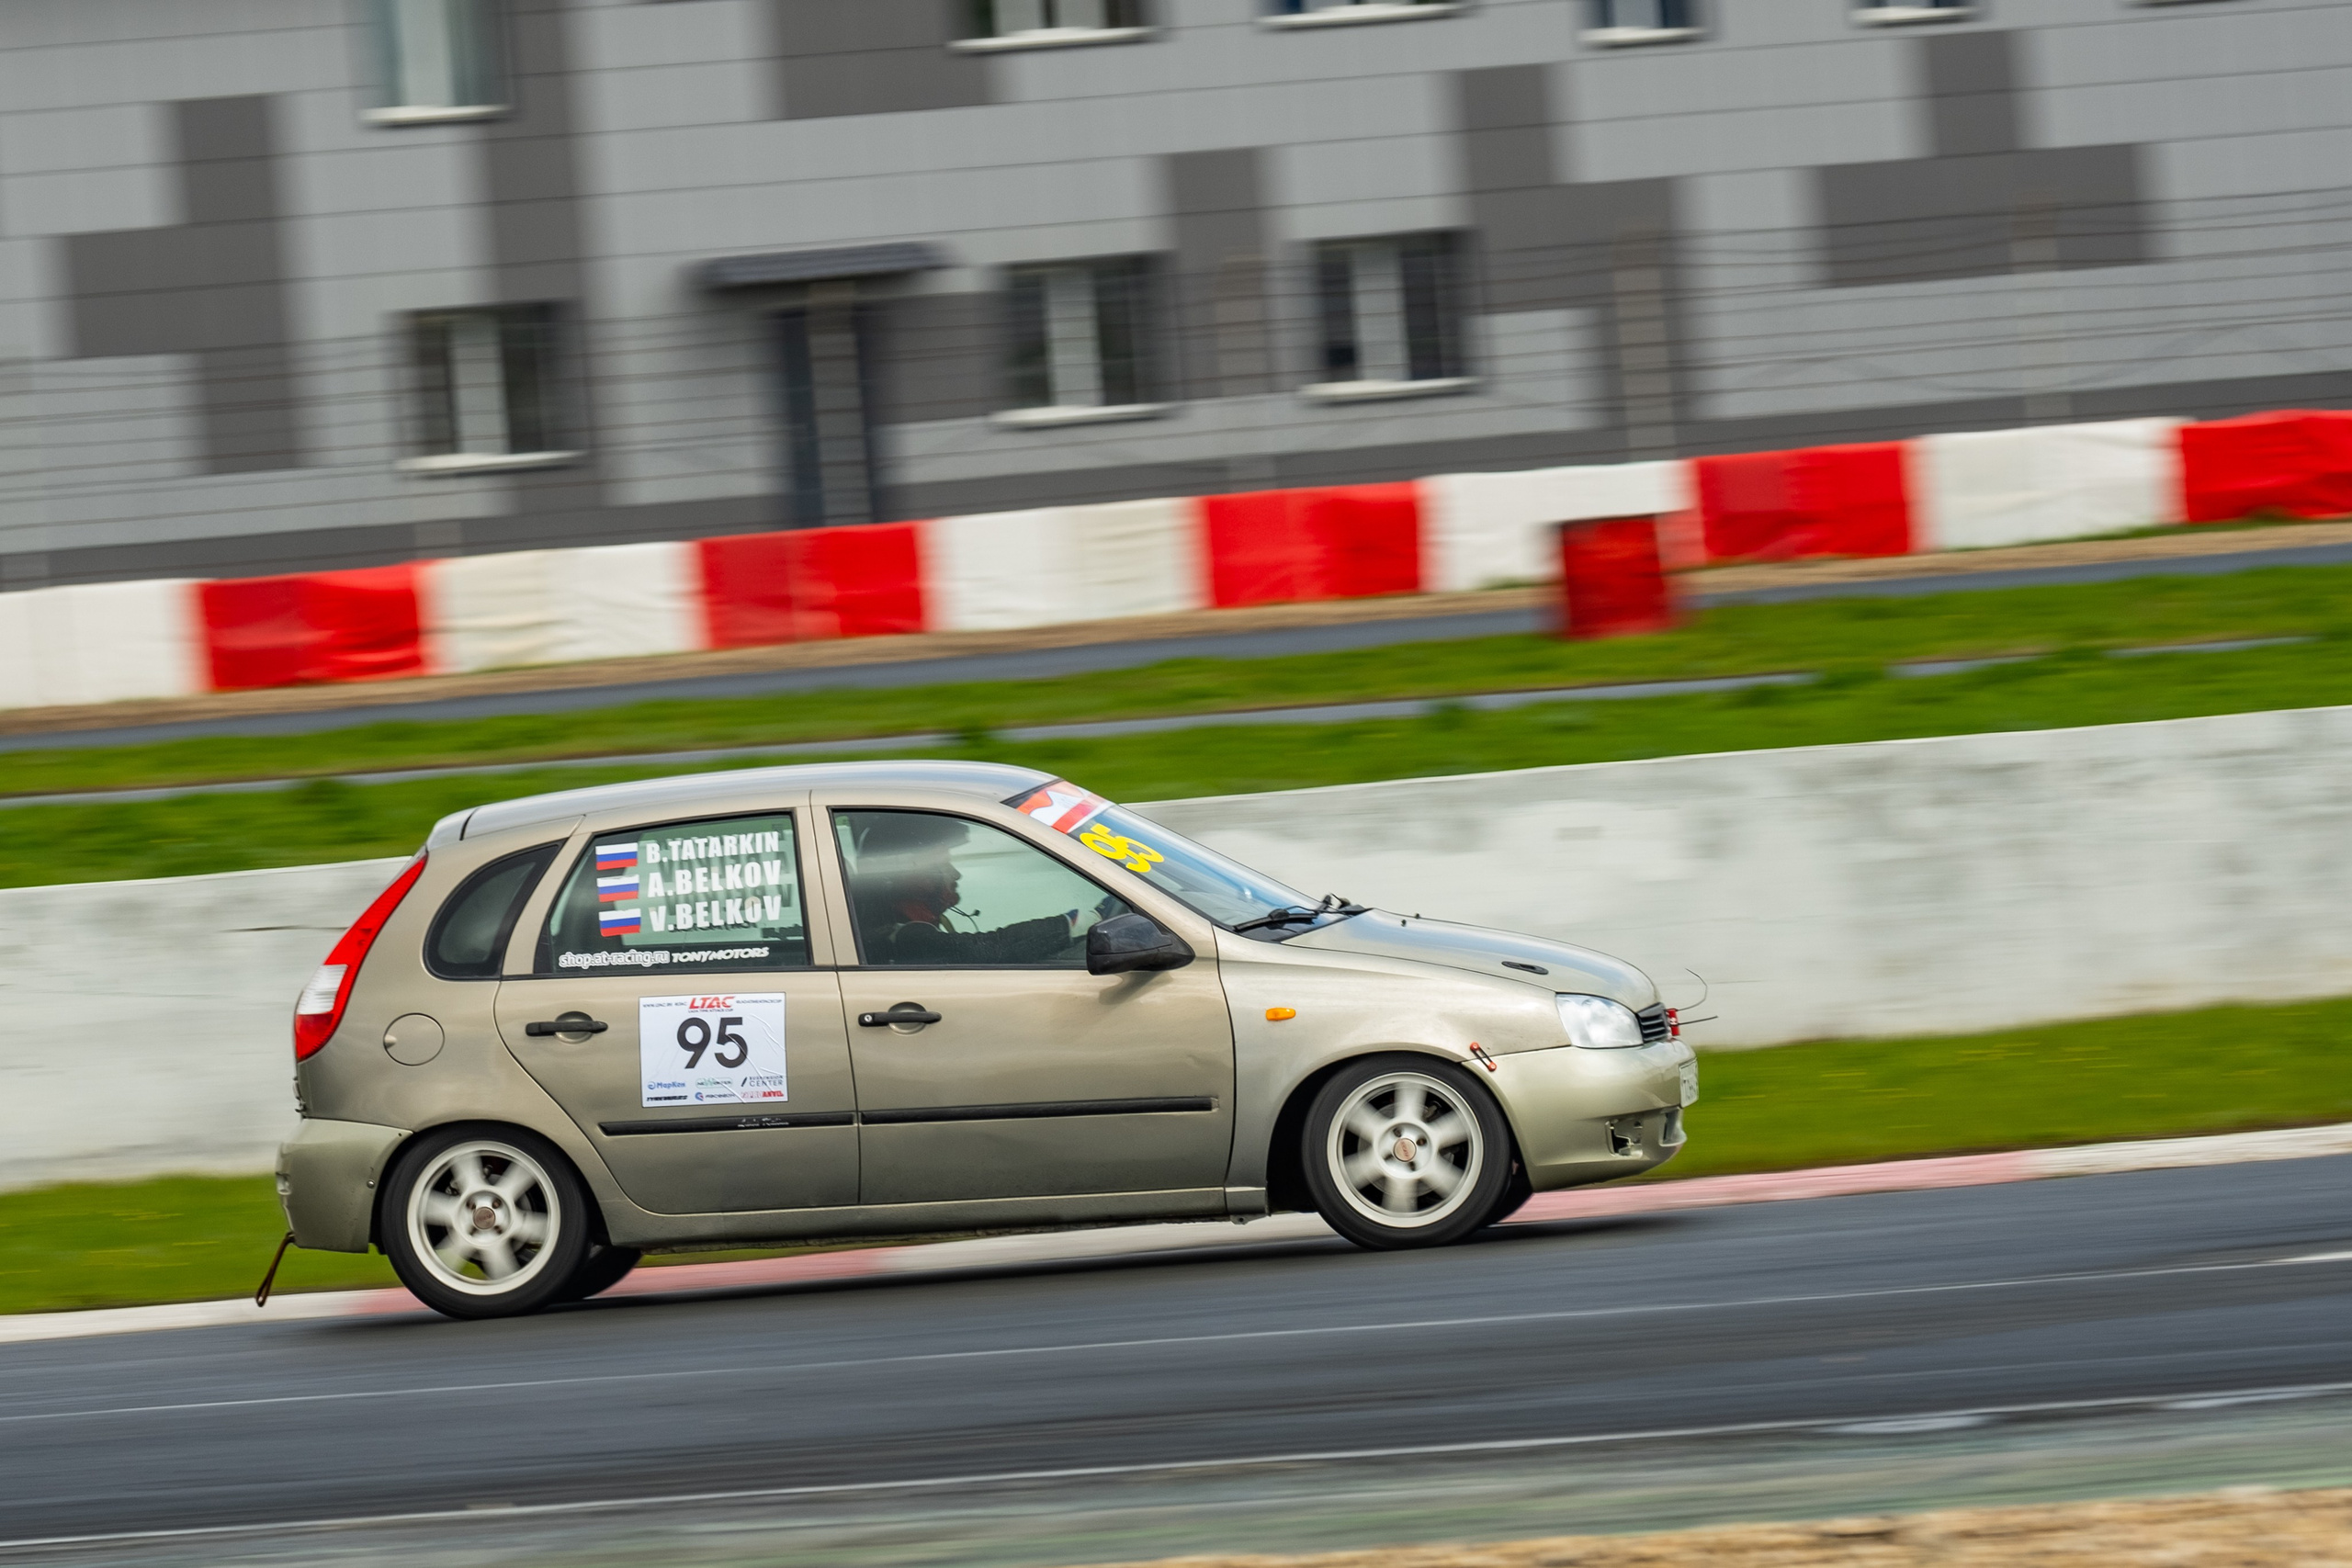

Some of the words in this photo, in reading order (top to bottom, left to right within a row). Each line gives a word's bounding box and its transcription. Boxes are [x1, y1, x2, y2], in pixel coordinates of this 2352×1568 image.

[1080, 823, 1165, 873] 95
[647, 860, 782, 898] A.BELKOV
[649, 895, 782, 932] V.BELKOV
[688, 996, 736, 1010] LTAC
[677, 1017, 749, 1069] 95
